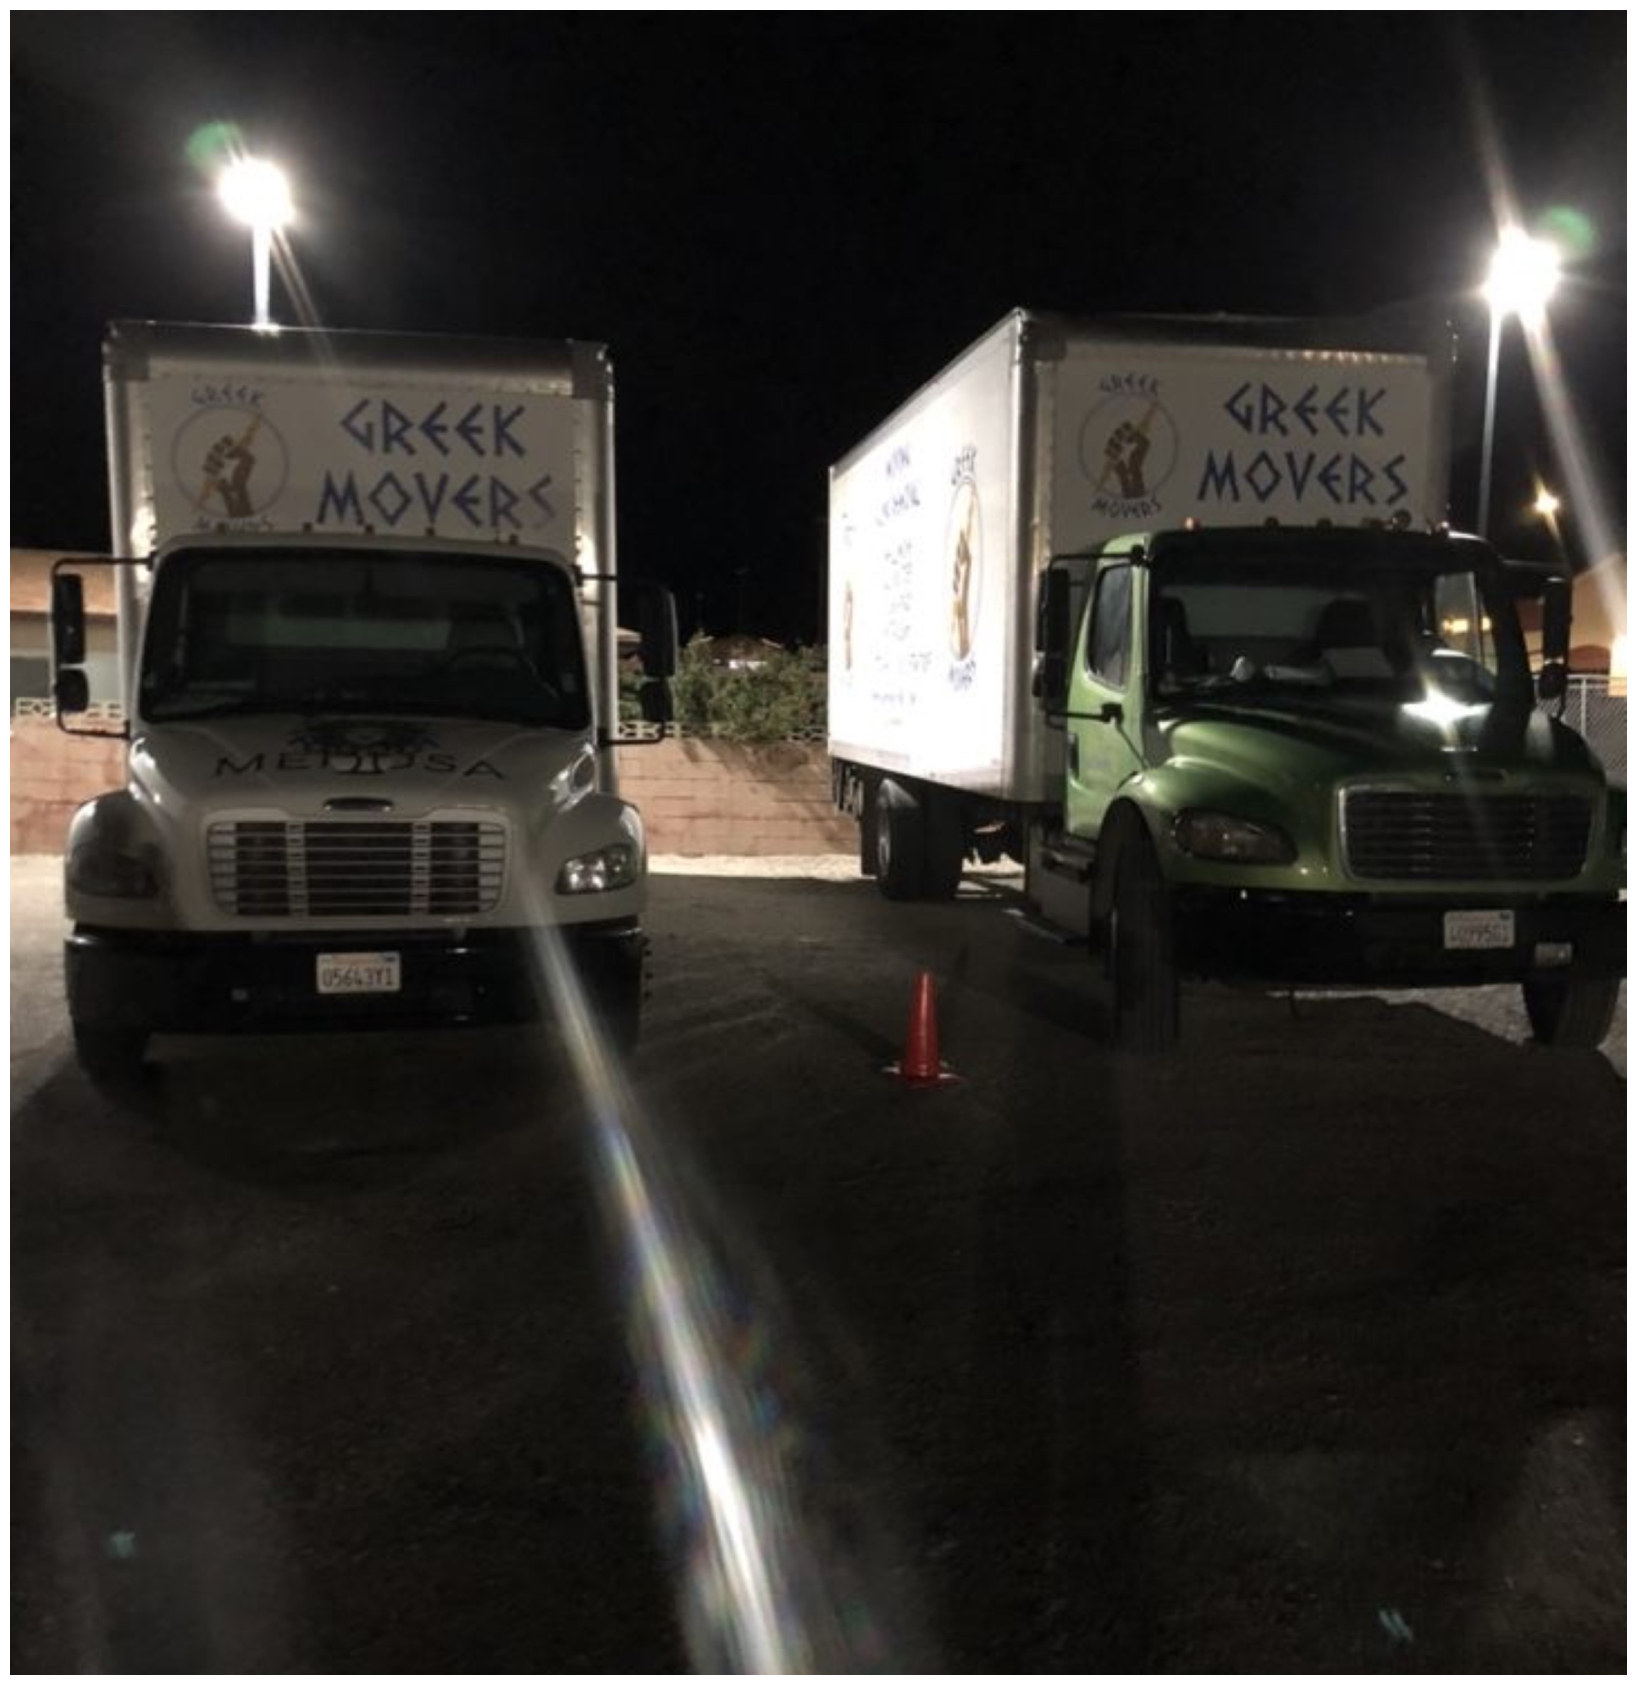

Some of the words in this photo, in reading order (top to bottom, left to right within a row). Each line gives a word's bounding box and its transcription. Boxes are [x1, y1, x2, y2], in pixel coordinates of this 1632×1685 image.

[341, 398, 526, 457] GREEK
[1224, 381, 1387, 437] GREEK
[317, 470, 556, 529] MOVERS
[1197, 450, 1408, 506] MOVERS
[1091, 497, 1163, 518] MOVERS
